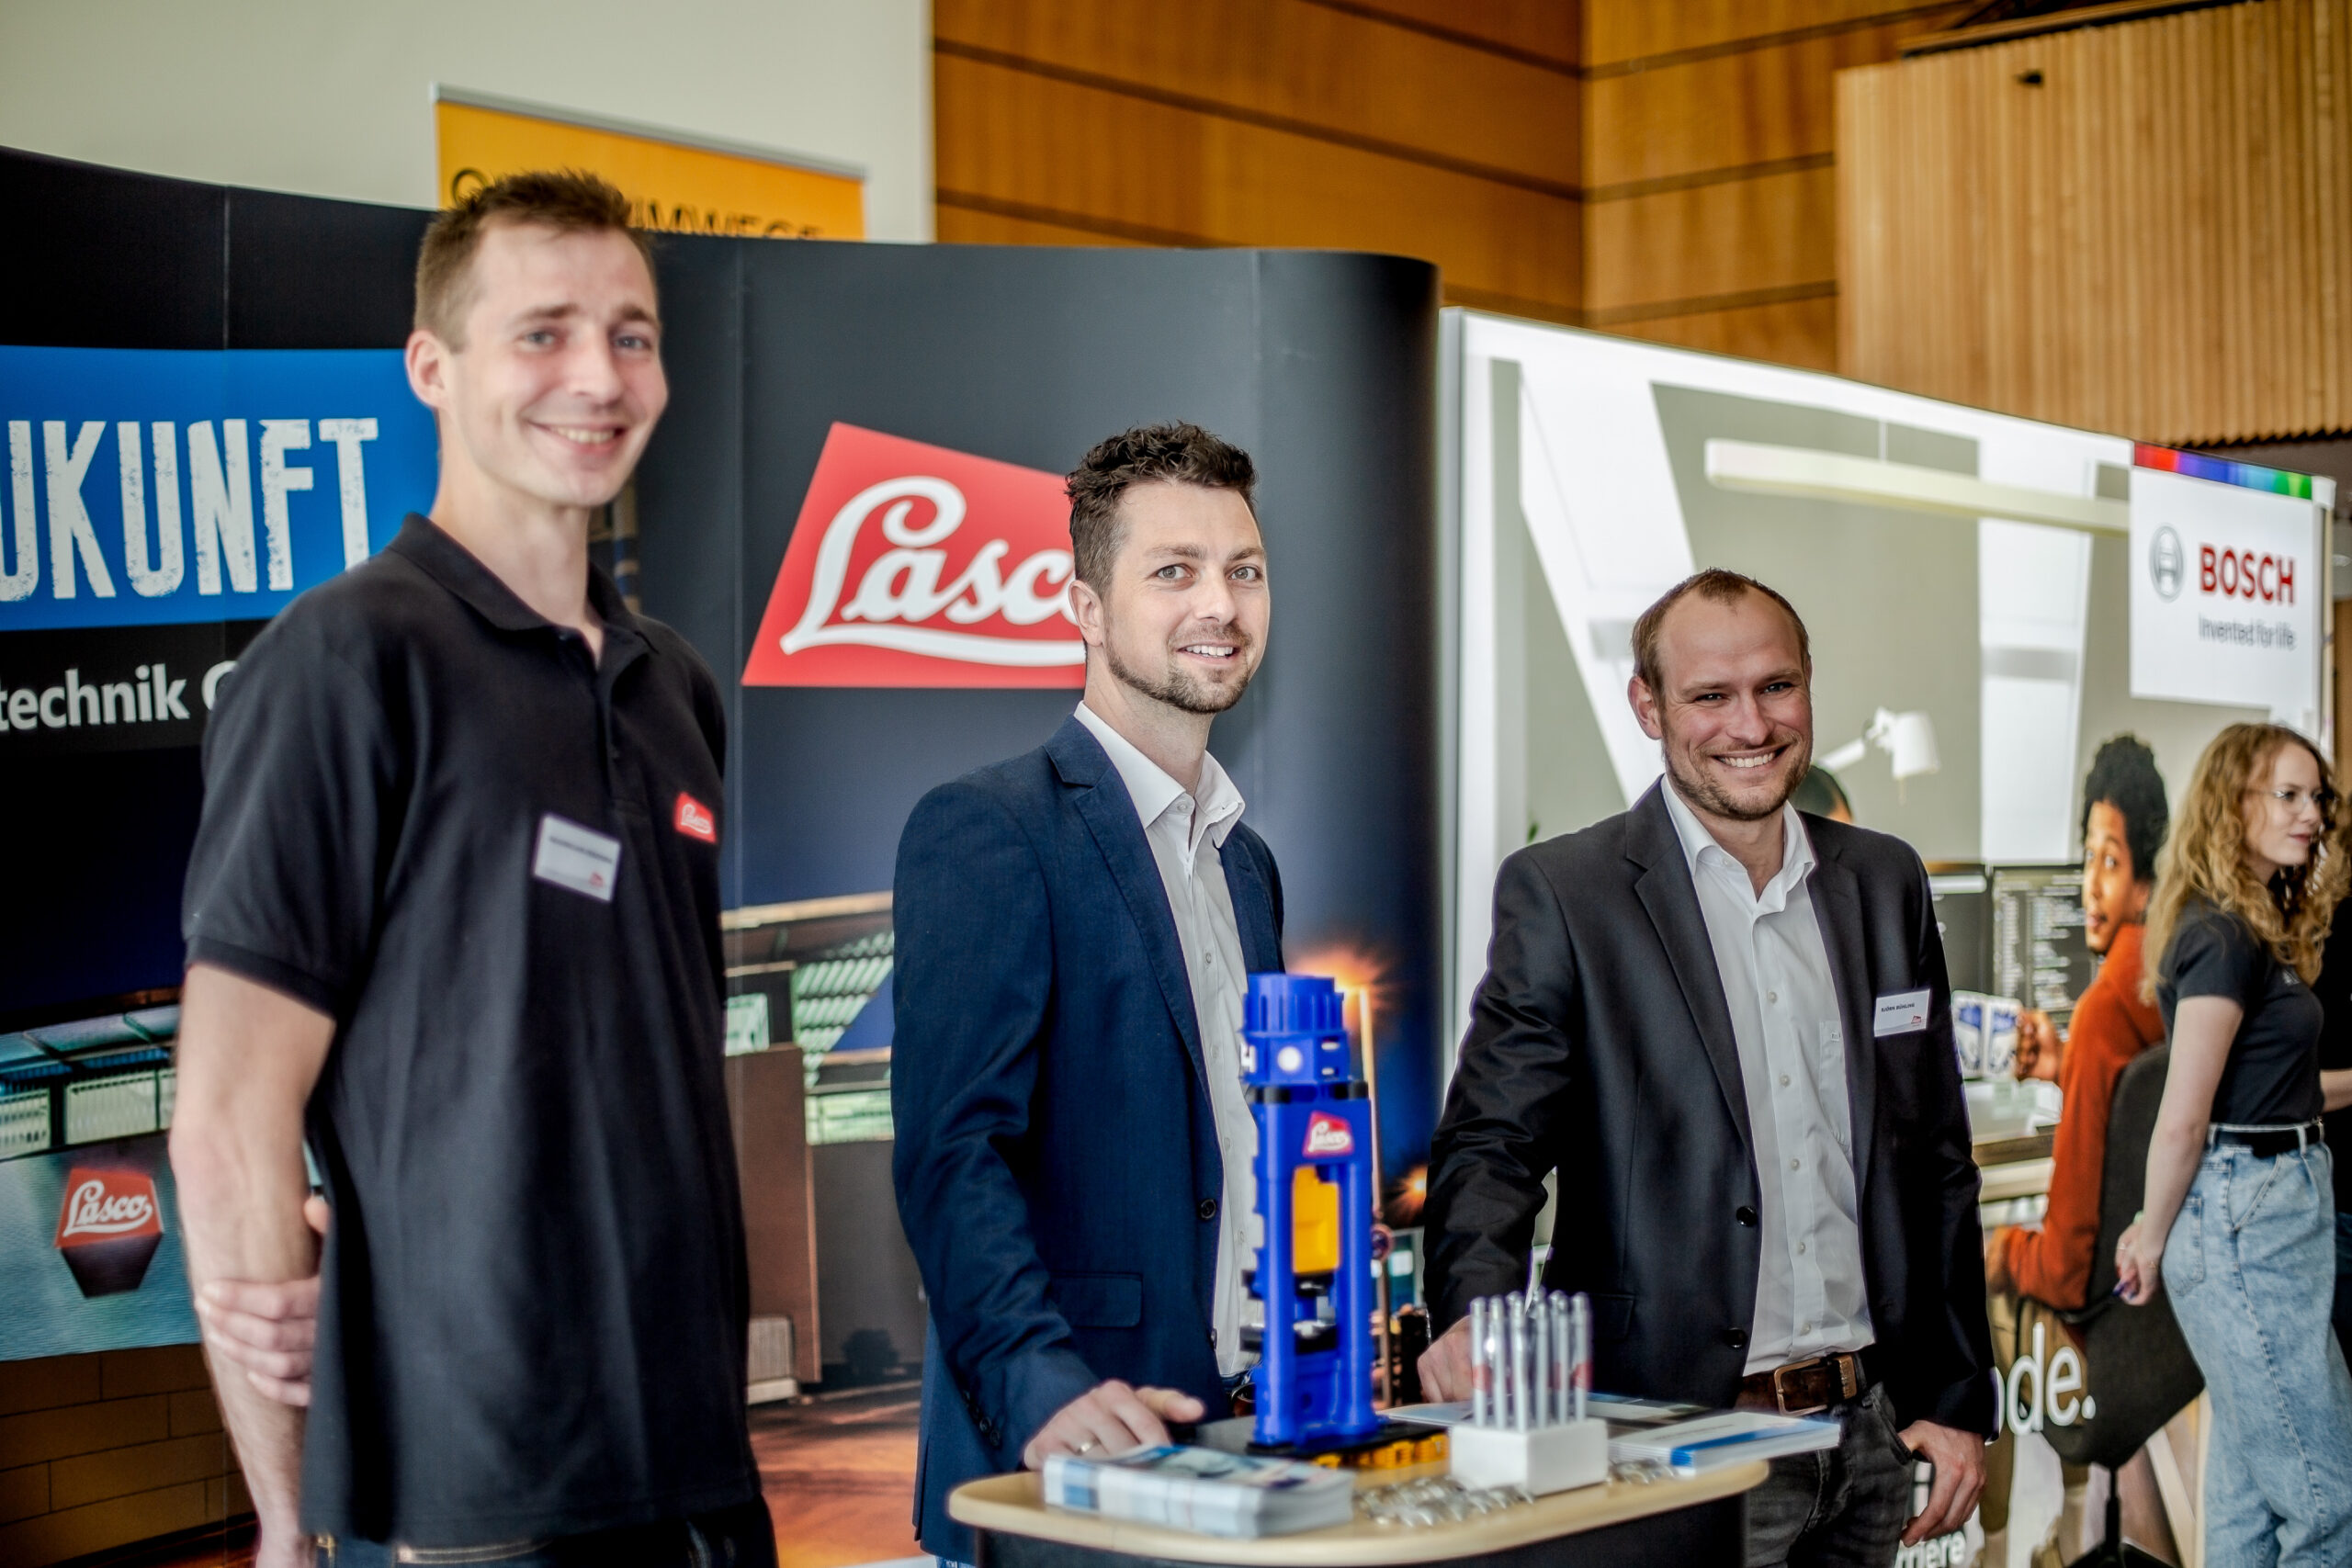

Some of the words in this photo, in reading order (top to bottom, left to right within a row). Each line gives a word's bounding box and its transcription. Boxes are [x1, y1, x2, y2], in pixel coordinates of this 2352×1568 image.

[0, 418, 378, 602] UKUNFT
[780, 475, 1087, 666] Lasc
[2199, 542, 2295, 605] BOSCH
[2198, 612, 2254, 646] Invented
[2256, 617, 2275, 648] for
[2276, 621, 2297, 651] life
[62, 1179, 153, 1237] Lasco
